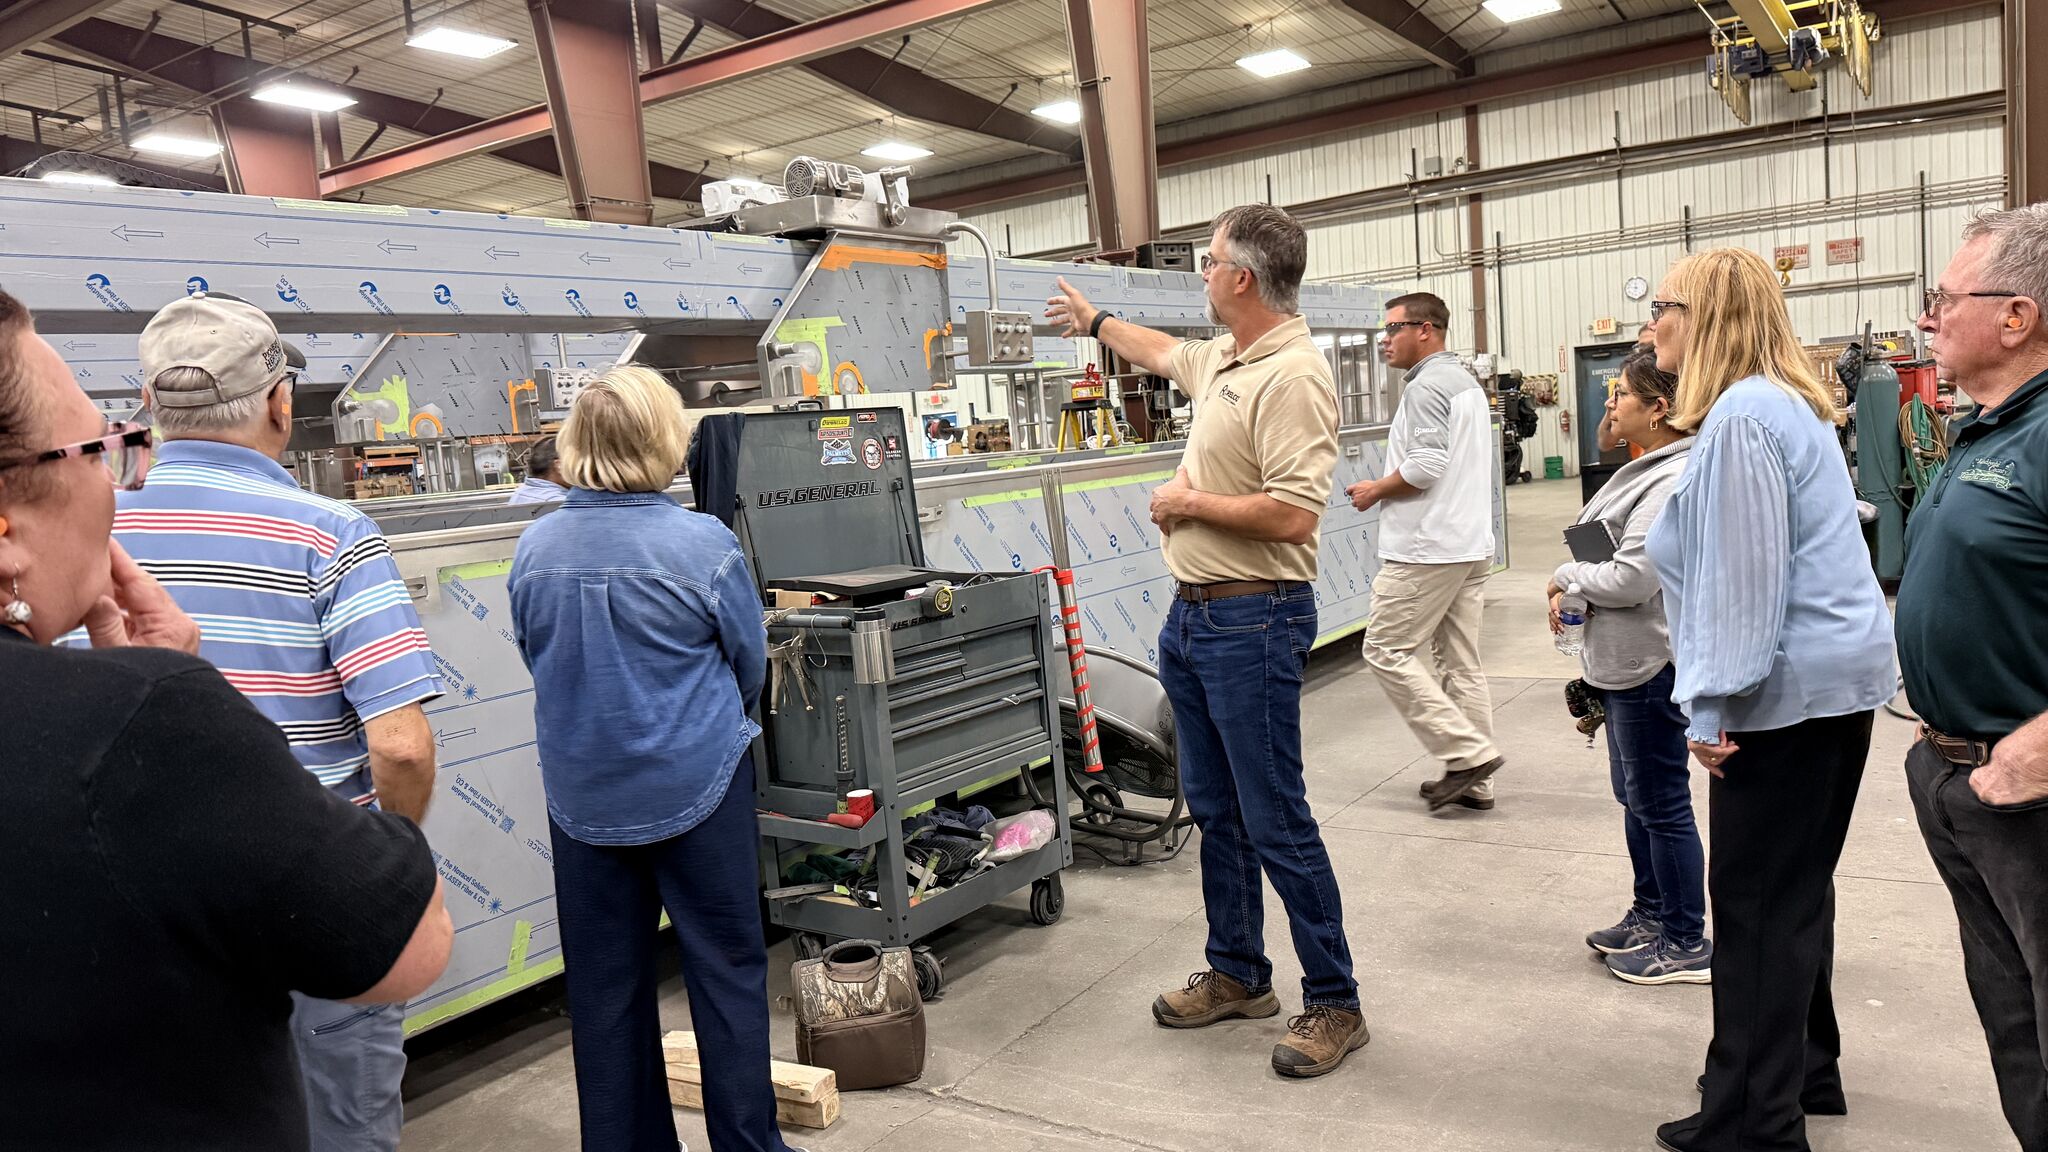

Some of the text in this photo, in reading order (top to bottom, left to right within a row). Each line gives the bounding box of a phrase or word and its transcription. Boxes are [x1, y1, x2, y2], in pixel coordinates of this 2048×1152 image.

[1597, 319, 1611, 330] EXIT
[442, 661, 465, 682] Solution
[466, 786, 481, 799] Fiber
[449, 784, 498, 824] The Novacel Solution
[478, 795, 496, 811] LASER
[494, 806, 504, 816] for
[436, 866, 447, 876] for
[444, 872, 463, 888] LASER
[460, 883, 475, 897] Fiber
[442, 858, 491, 896] The Novacel Solution
